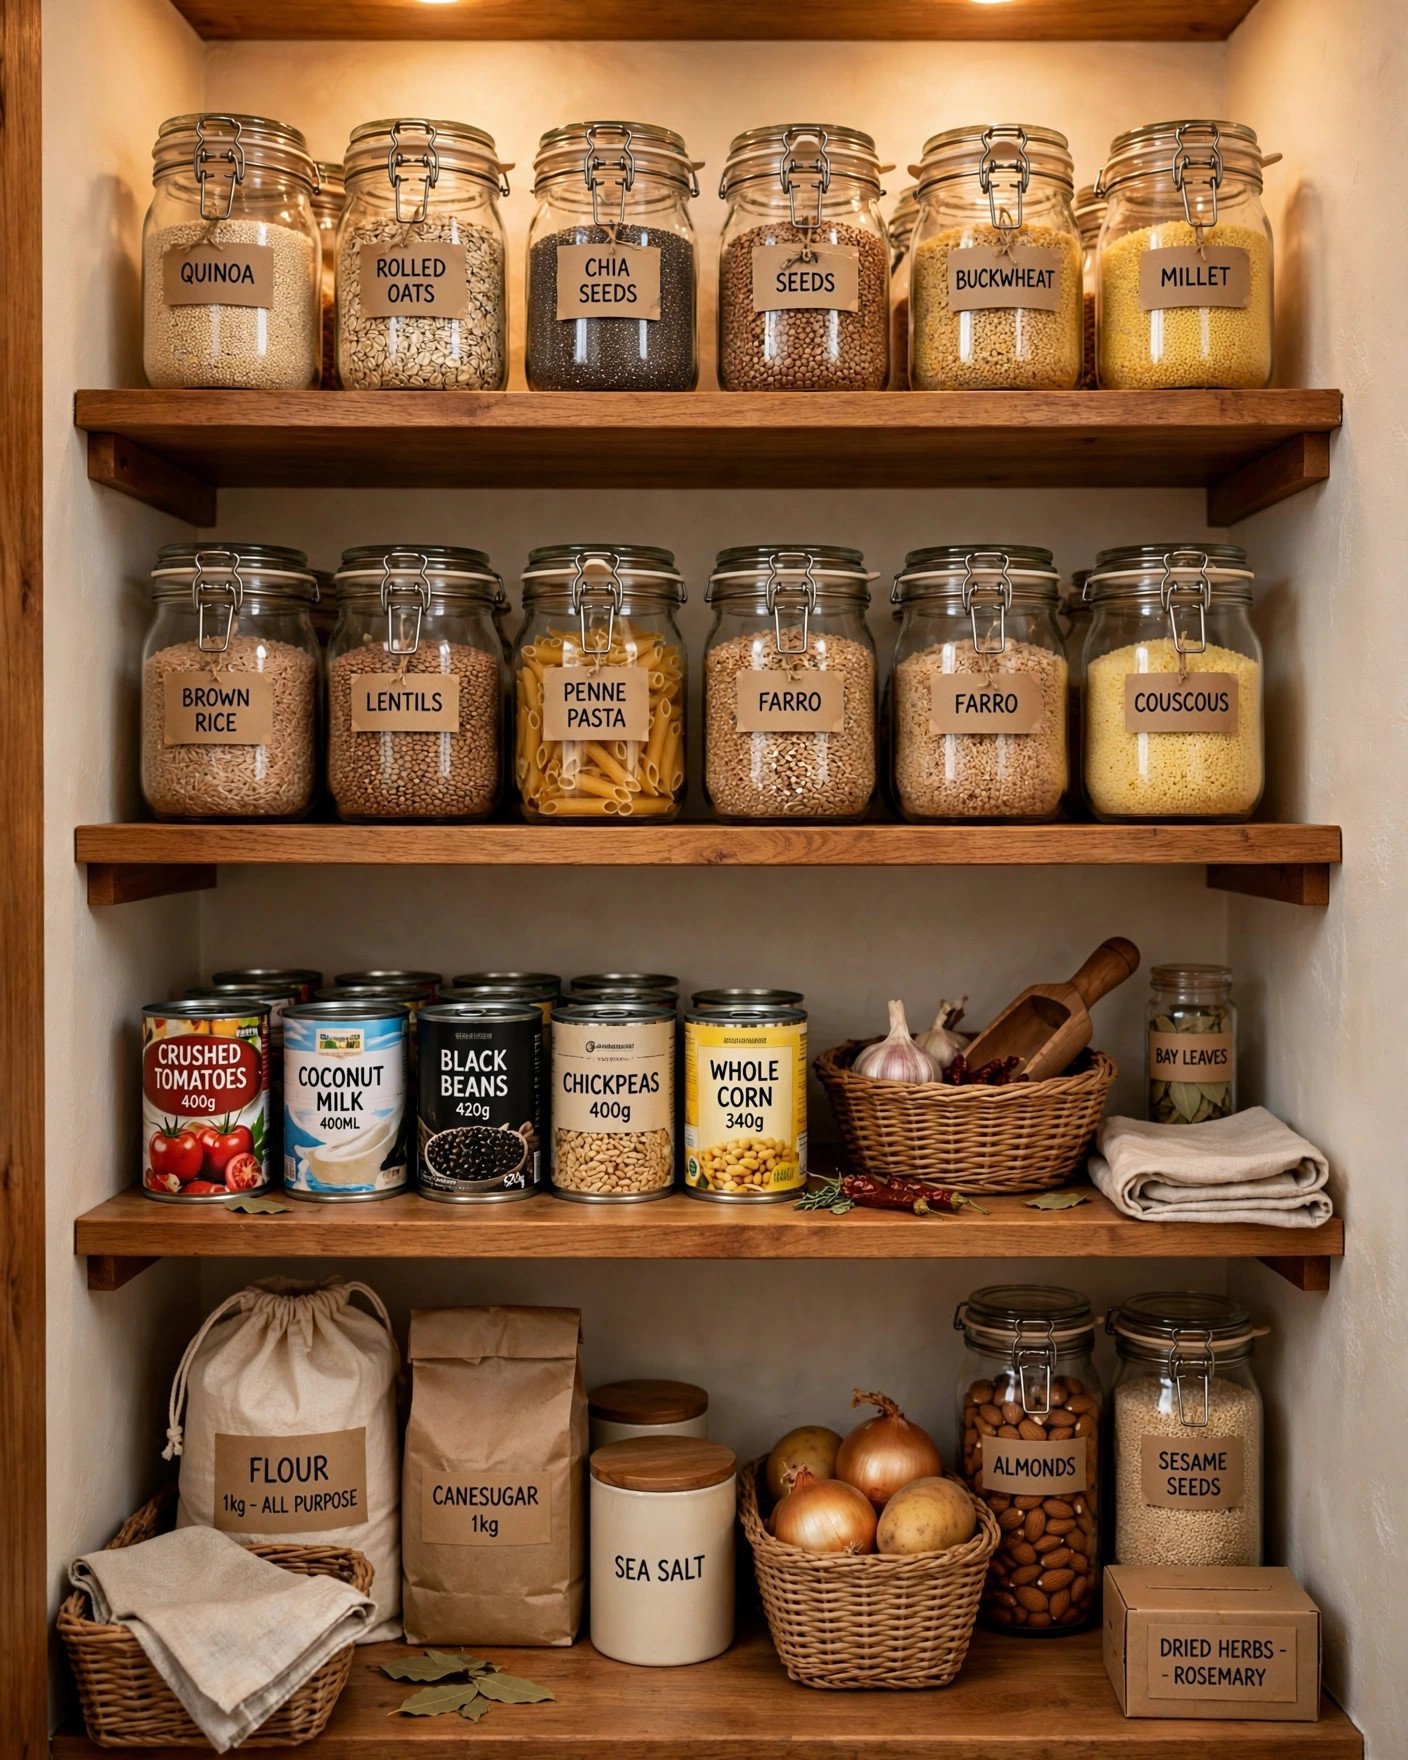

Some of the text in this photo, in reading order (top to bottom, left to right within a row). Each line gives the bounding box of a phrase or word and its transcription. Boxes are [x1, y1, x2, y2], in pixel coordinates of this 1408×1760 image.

[181, 262, 254, 284] QUINOA
[377, 258, 445, 278] ROLLED
[586, 258, 629, 277] CHIA
[1162, 266, 1230, 287] MILLET
[776, 272, 834, 292] SEEDS
[955, 268, 1055, 290] BUCKWHEAT
[388, 284, 434, 303] OATS
[580, 284, 637, 303] SEEDS
[183, 688, 249, 707] BROWN
[565, 682, 626, 701] PENNE
[760, 692, 821, 711] FARRO
[367, 692, 442, 712] LENTILS
[956, 693, 1018, 713] FARRO
[1135, 692, 1229, 712] COUSCOUS
[196, 713, 236, 732] RICE
[568, 708, 626, 727] PASTA
[159, 1044, 241, 1065] CRUSHED
[442, 1050, 507, 1071] BLACK
[1156, 1048, 1228, 1065] BAY LEAVES
[155, 1067, 246, 1090] TOMATOES
[299, 1066, 384, 1088] COCONUT
[710, 1060, 778, 1081] WHOLE
[442, 1075, 508, 1097] BEANS
[563, 1072, 659, 1094] CHICKPEAS
[182, 1095, 215, 1111] 400g
[317, 1091, 363, 1111] MILK
[718, 1086, 772, 1107] CORN
[456, 1103, 489, 1120] 420g
[590, 1102, 630, 1123] 400g
[320, 1117, 360, 1130] 400ML
[726, 1113, 763, 1132] 340g
[250, 1455, 328, 1483] FLOUR
[994, 1456, 1075, 1477] ALMONDS
[1159, 1451, 1227, 1471] SESAME
[433, 1485, 538, 1506] CANESUGAR
[1167, 1477, 1221, 1496] SEEDS
[224, 1494, 245, 1517] 1kg
[262, 1496, 288, 1513] ALL
[295, 1489, 357, 1512] PURPOSE
[472, 1515, 498, 1537] 1kg
[615, 1555, 705, 1581] SEA SALT
[1161, 1638, 1211, 1657] DRIED
[1219, 1640, 1273, 1659] HERBS
[1175, 1666, 1266, 1686] ROSEMARY
